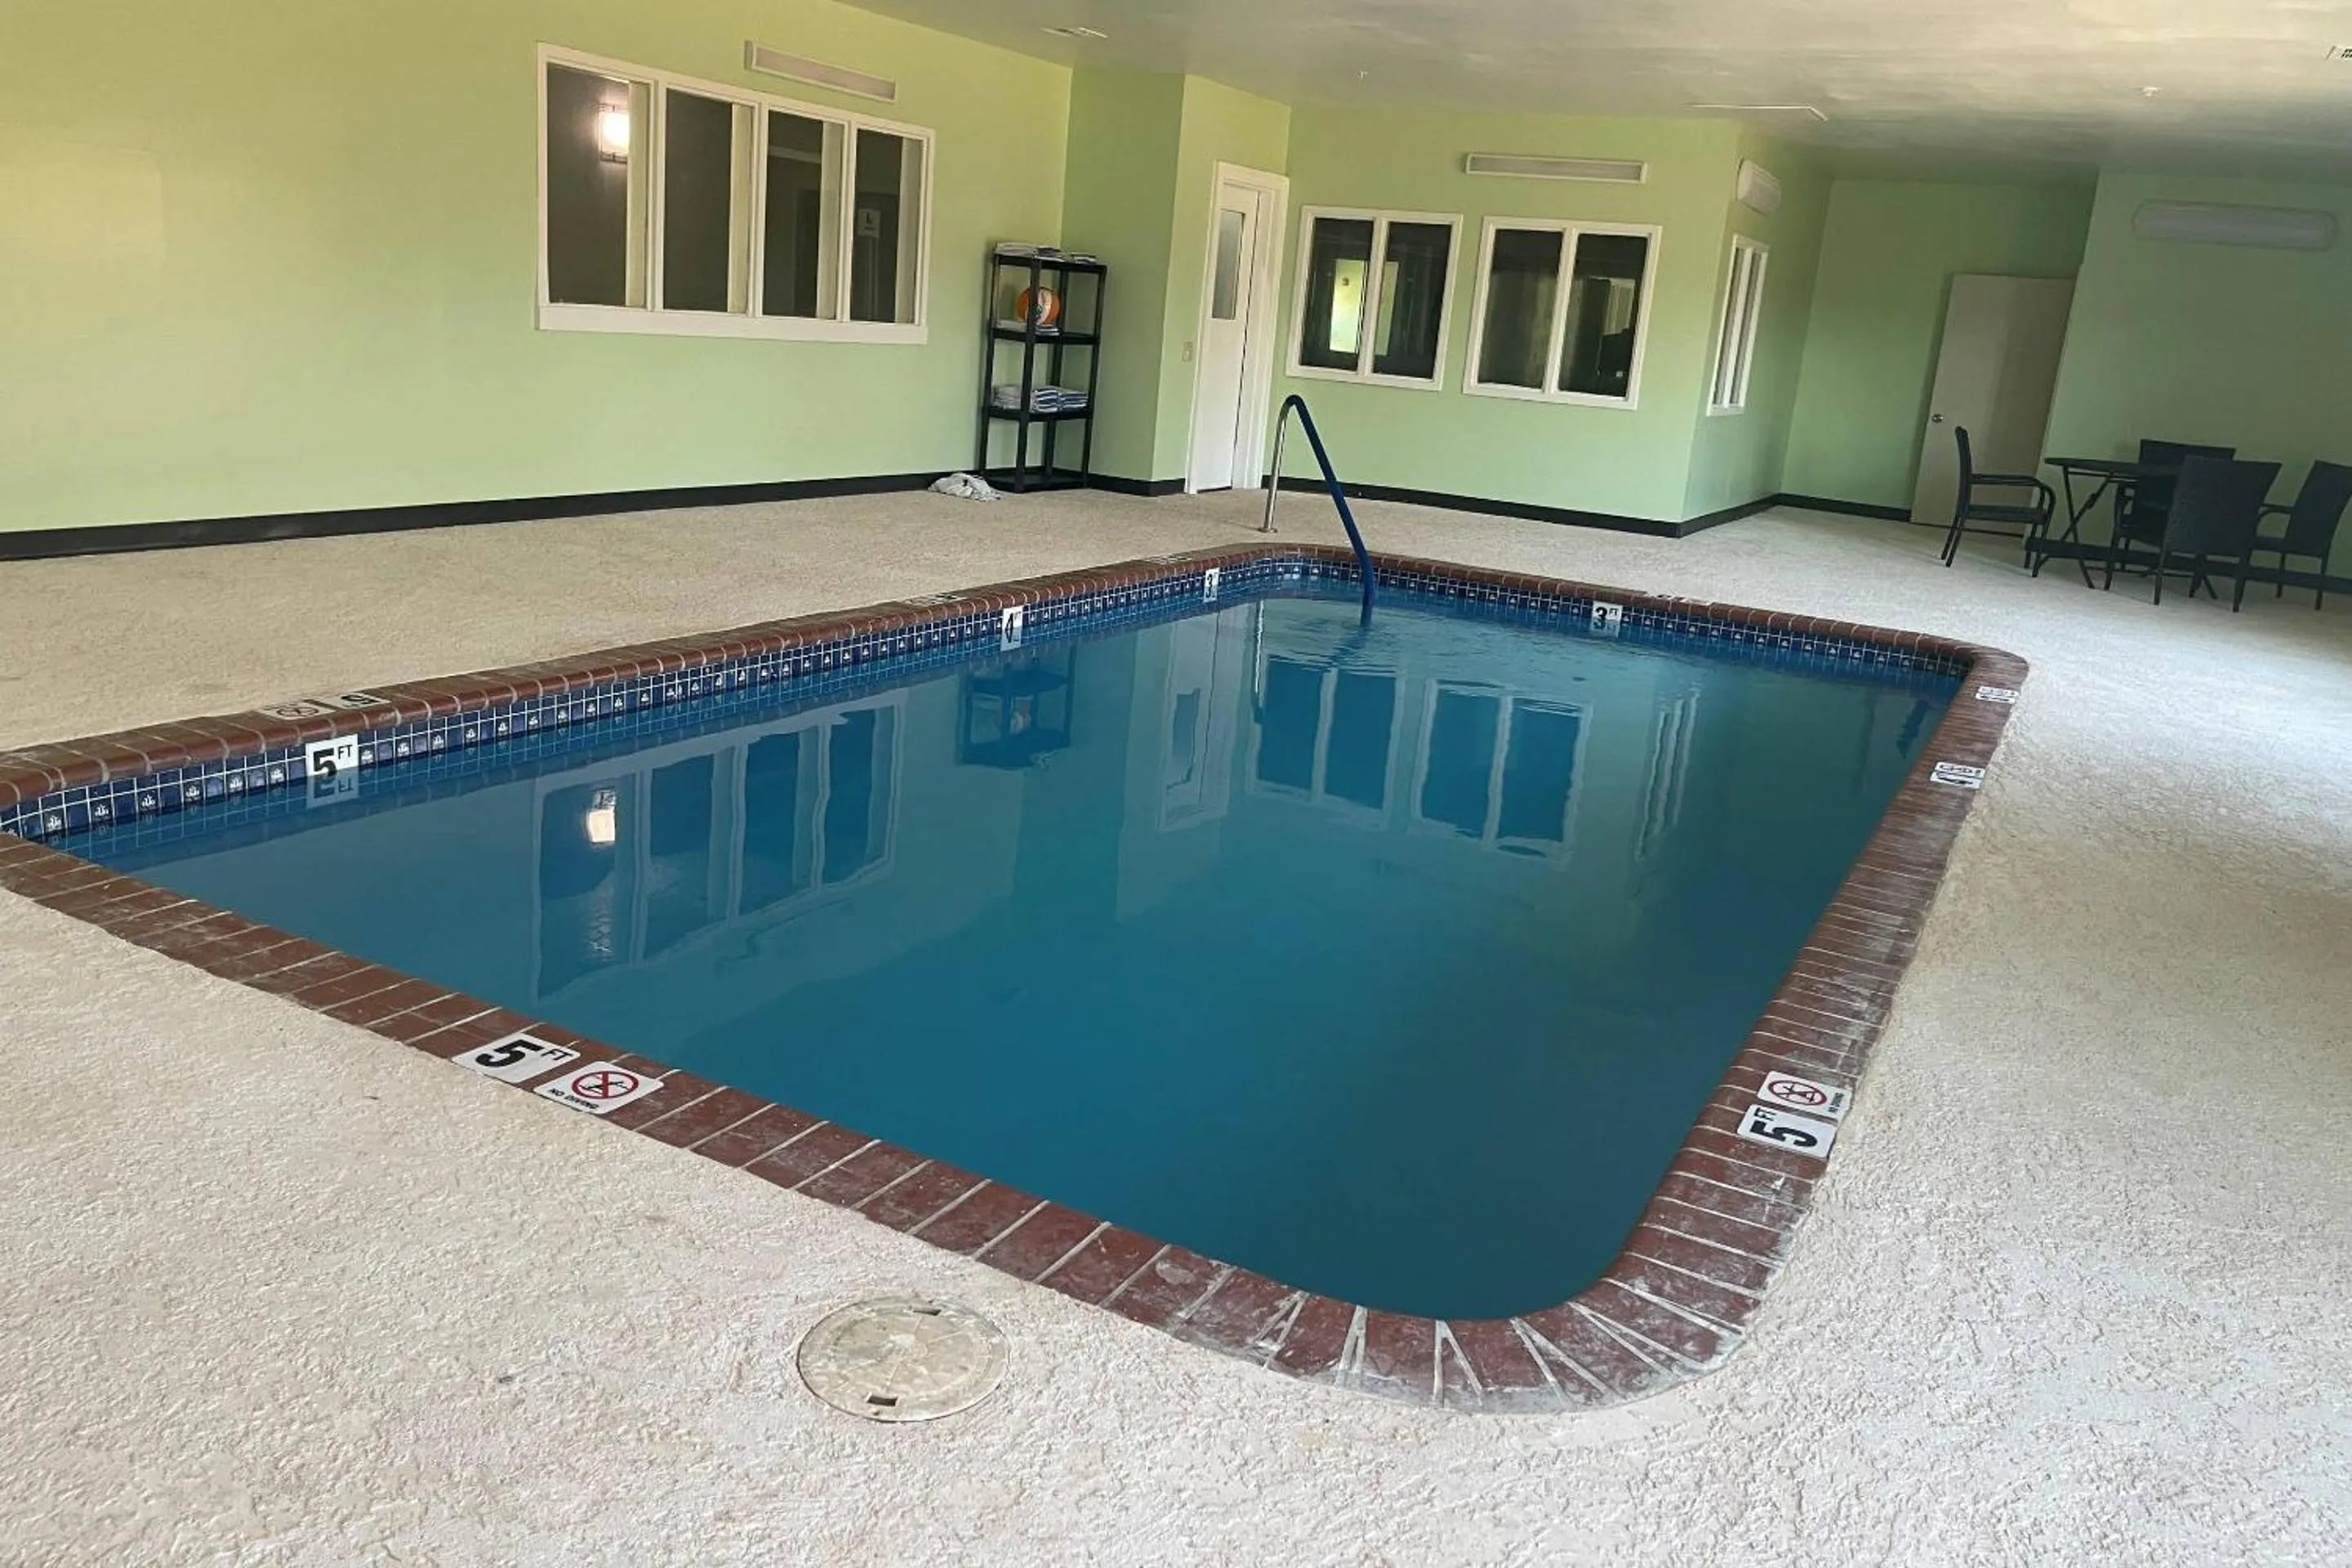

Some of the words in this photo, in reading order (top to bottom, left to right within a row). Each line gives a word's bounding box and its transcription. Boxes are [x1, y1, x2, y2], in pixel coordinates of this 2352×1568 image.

[1595, 607, 1608, 624] 3
[313, 747, 337, 777] 5
[338, 745, 352, 760] FT
[475, 1039, 544, 1067] 5
[541, 1048, 572, 1061] FT
[548, 1088, 565, 1097] NO
[1753, 1107, 1776, 1122] FT
[1749, 1120, 1818, 1147] 5
